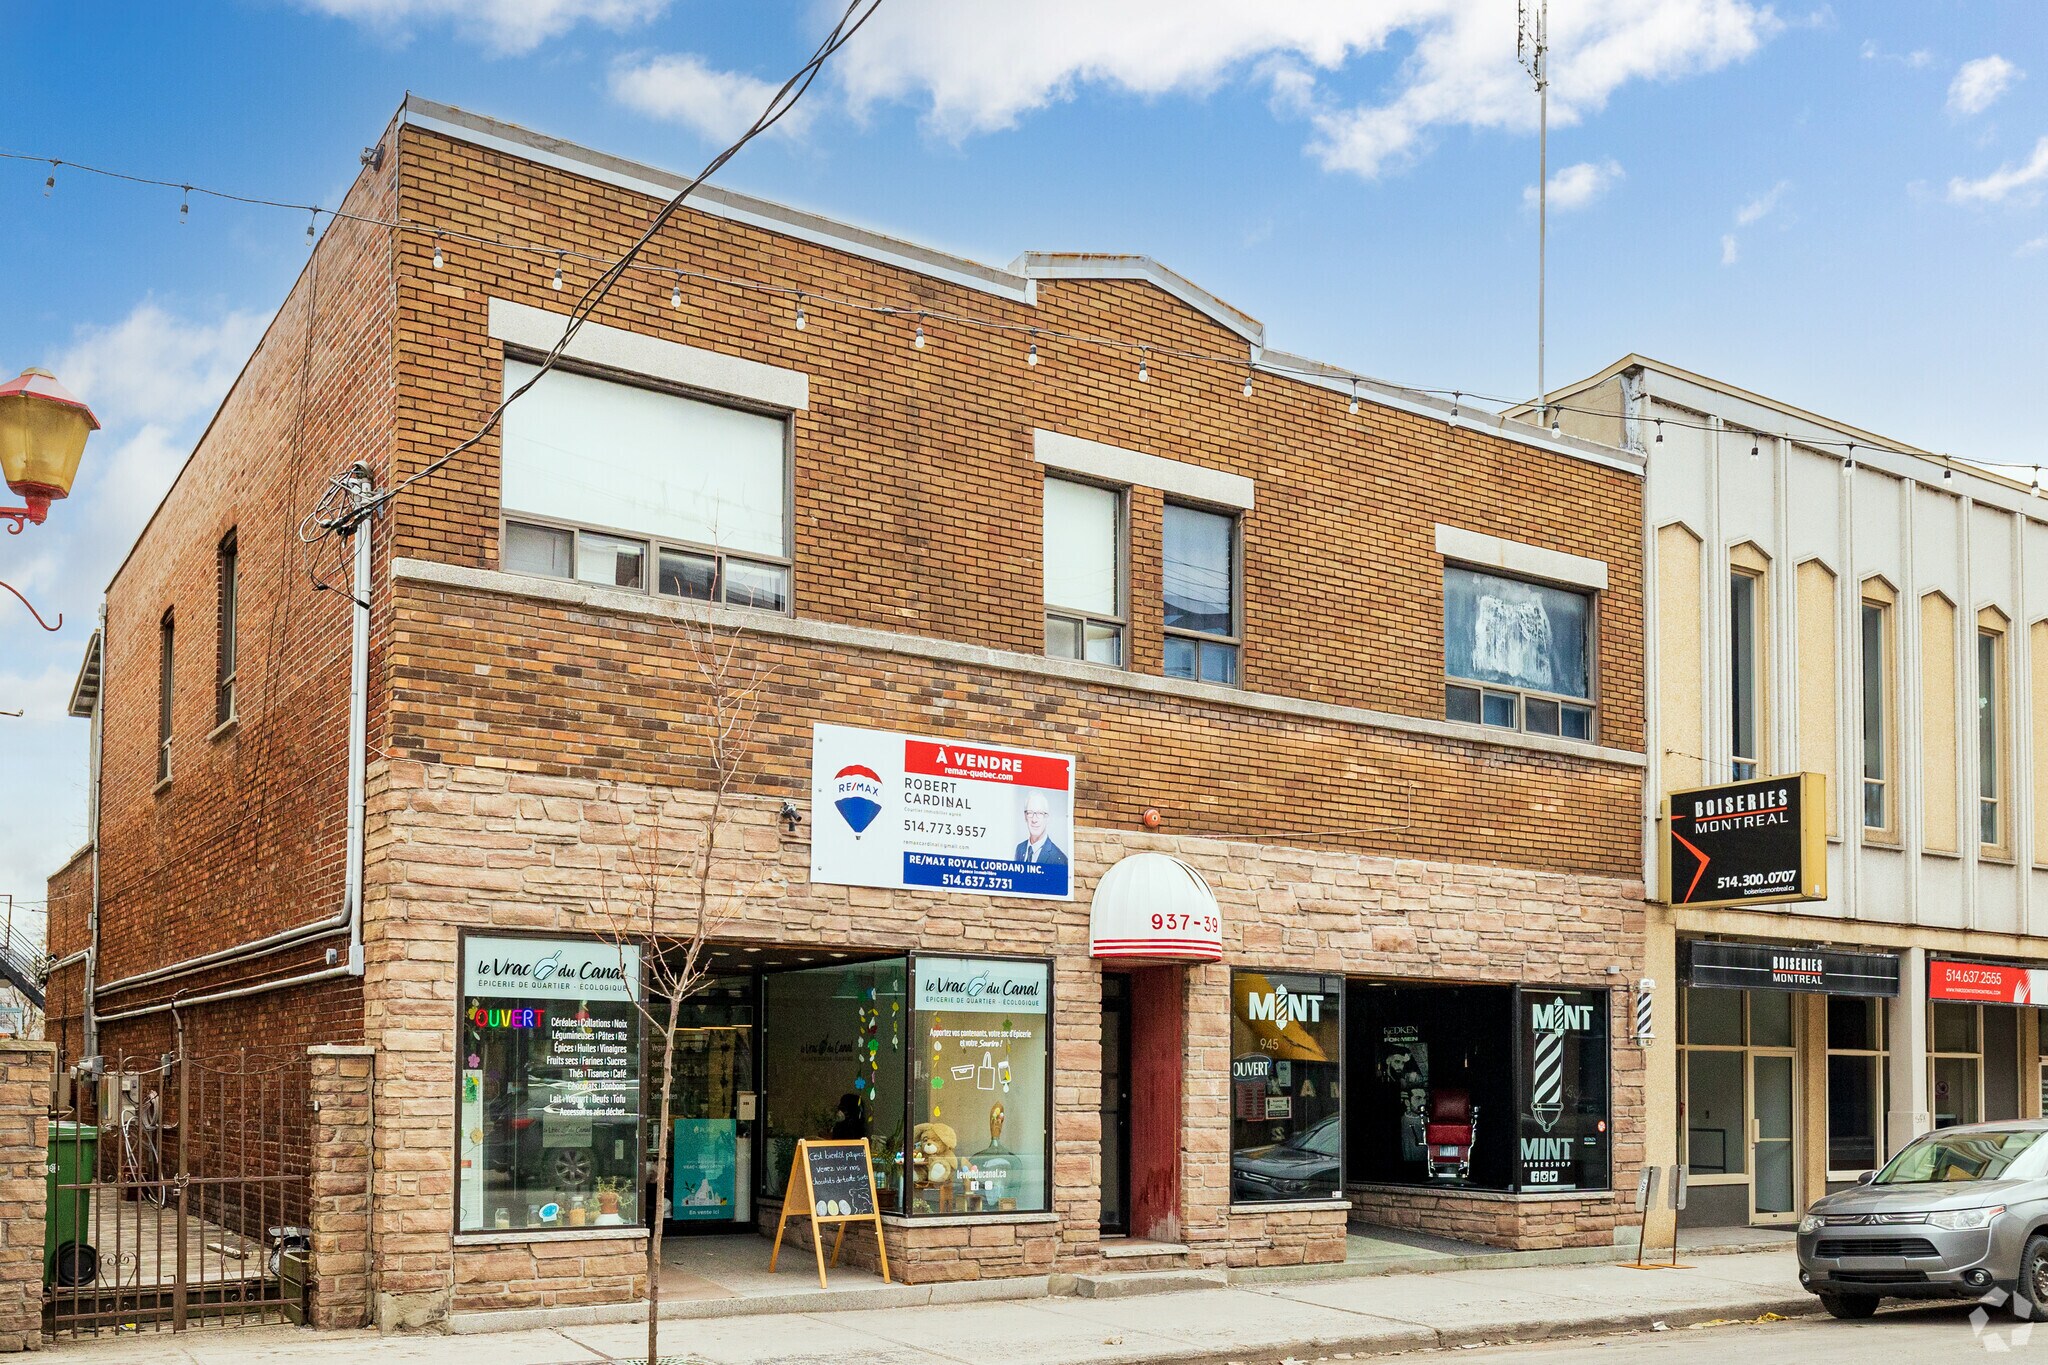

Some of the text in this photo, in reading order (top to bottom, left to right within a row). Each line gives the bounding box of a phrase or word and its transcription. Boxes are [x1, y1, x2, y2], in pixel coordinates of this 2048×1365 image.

[936, 747, 1022, 772] À VENDRE
[944, 767, 1013, 781] remax-quebec.com
[838, 782, 879, 797] RE/MAX
[904, 778, 957, 794] ROBERT
[904, 792, 972, 810] CARDINAL
[1695, 789, 1788, 818] BOISERIES
[904, 820, 986, 838] 514.773.9557
[1695, 812, 1789, 834] MONTREAL
[909, 854, 1045, 874] RE/MAX ROYAL (JORDAN) INC.
[942, 874, 1013, 889] 514.637.3731
[1717, 870, 1797, 888] 514.300.0707
[1744, 886, 1795, 896] boiseriesmontreal.ca
[1151, 913, 1218, 933] 937-39
[477, 957, 626, 980] le Vrac du Canal
[1773, 956, 1822, 972] BOISERIES
[1773, 973, 1822, 984] MONTREAL
[1945, 969, 2002, 984] 514.637.2555
[478, 979, 515, 988] ÉPICERIE
[532, 982, 570, 990] QUARTIER
[926, 977, 1039, 996] le Vrac du Canal
[475, 1008, 545, 1028] OUVERT
[551, 1017, 627, 1028] Céréales Collations Noix
[552, 1030, 627, 1041] Légumineuses Pâtes Riz
[578, 1044, 596, 1052] Huiles
[600, 1044, 627, 1054] Vinaigres
[1260, 1038, 1279, 1050] 945
[546, 1056, 626, 1066] Fruits secs Farines Sucres
[569, 1069, 626, 1078] Thés Tisanes Café
[1233, 1062, 1269, 1077] OUVERT
[612, 1094, 626, 1103] Tofu
[1520, 1138, 1574, 1160] MINT
